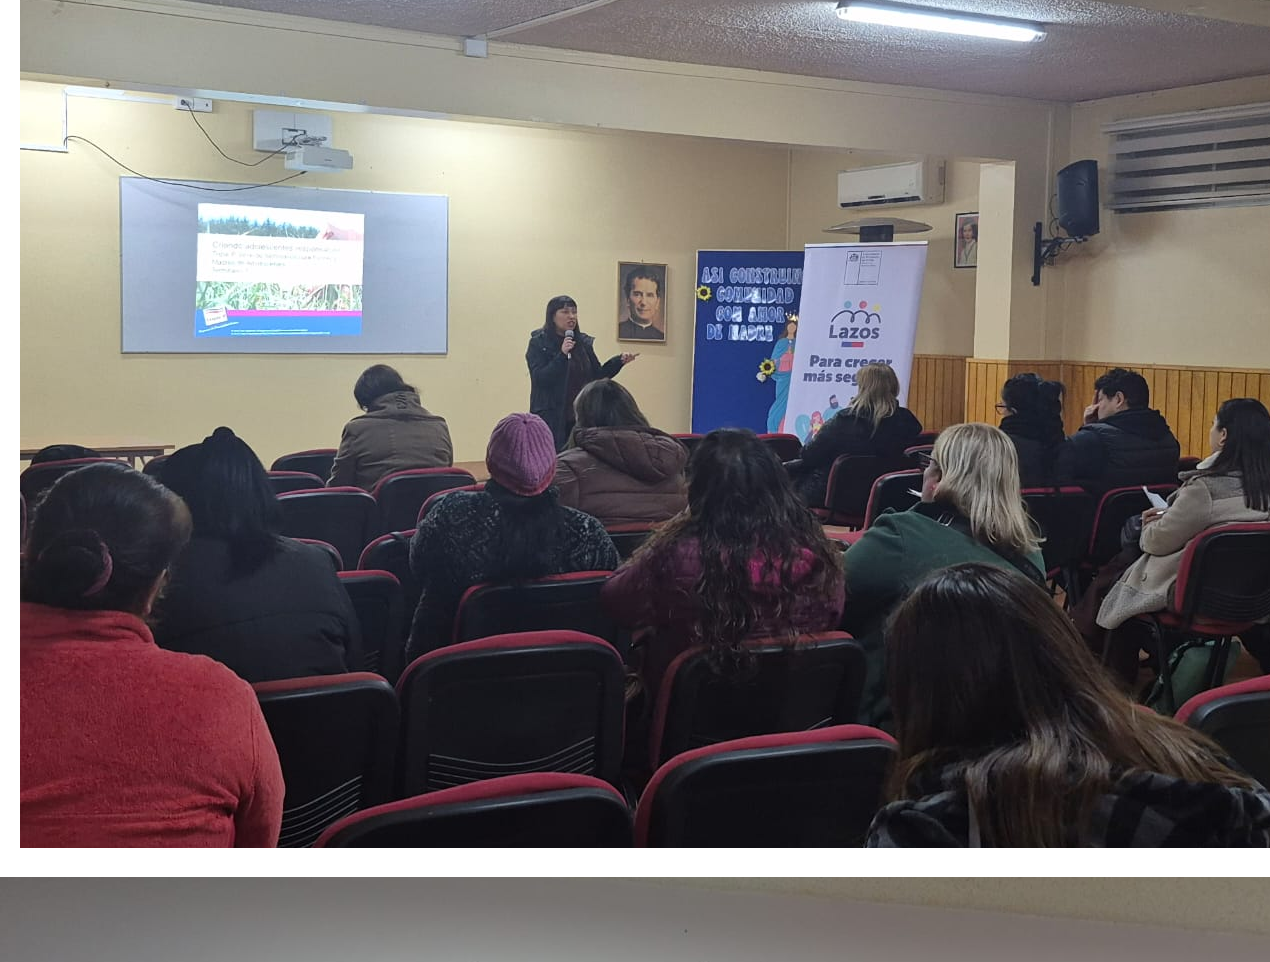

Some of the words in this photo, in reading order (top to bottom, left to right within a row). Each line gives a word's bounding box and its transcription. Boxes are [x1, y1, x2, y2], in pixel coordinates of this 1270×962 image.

[701, 266, 724, 284] ASI
[716, 286, 794, 304] COMUNIDAD
[715, 305, 742, 322] CON
[748, 306, 785, 323] AMOR
[828, 324, 880, 339] Lazos
[809, 354, 842, 368] Para
[802, 369, 833, 382] más
